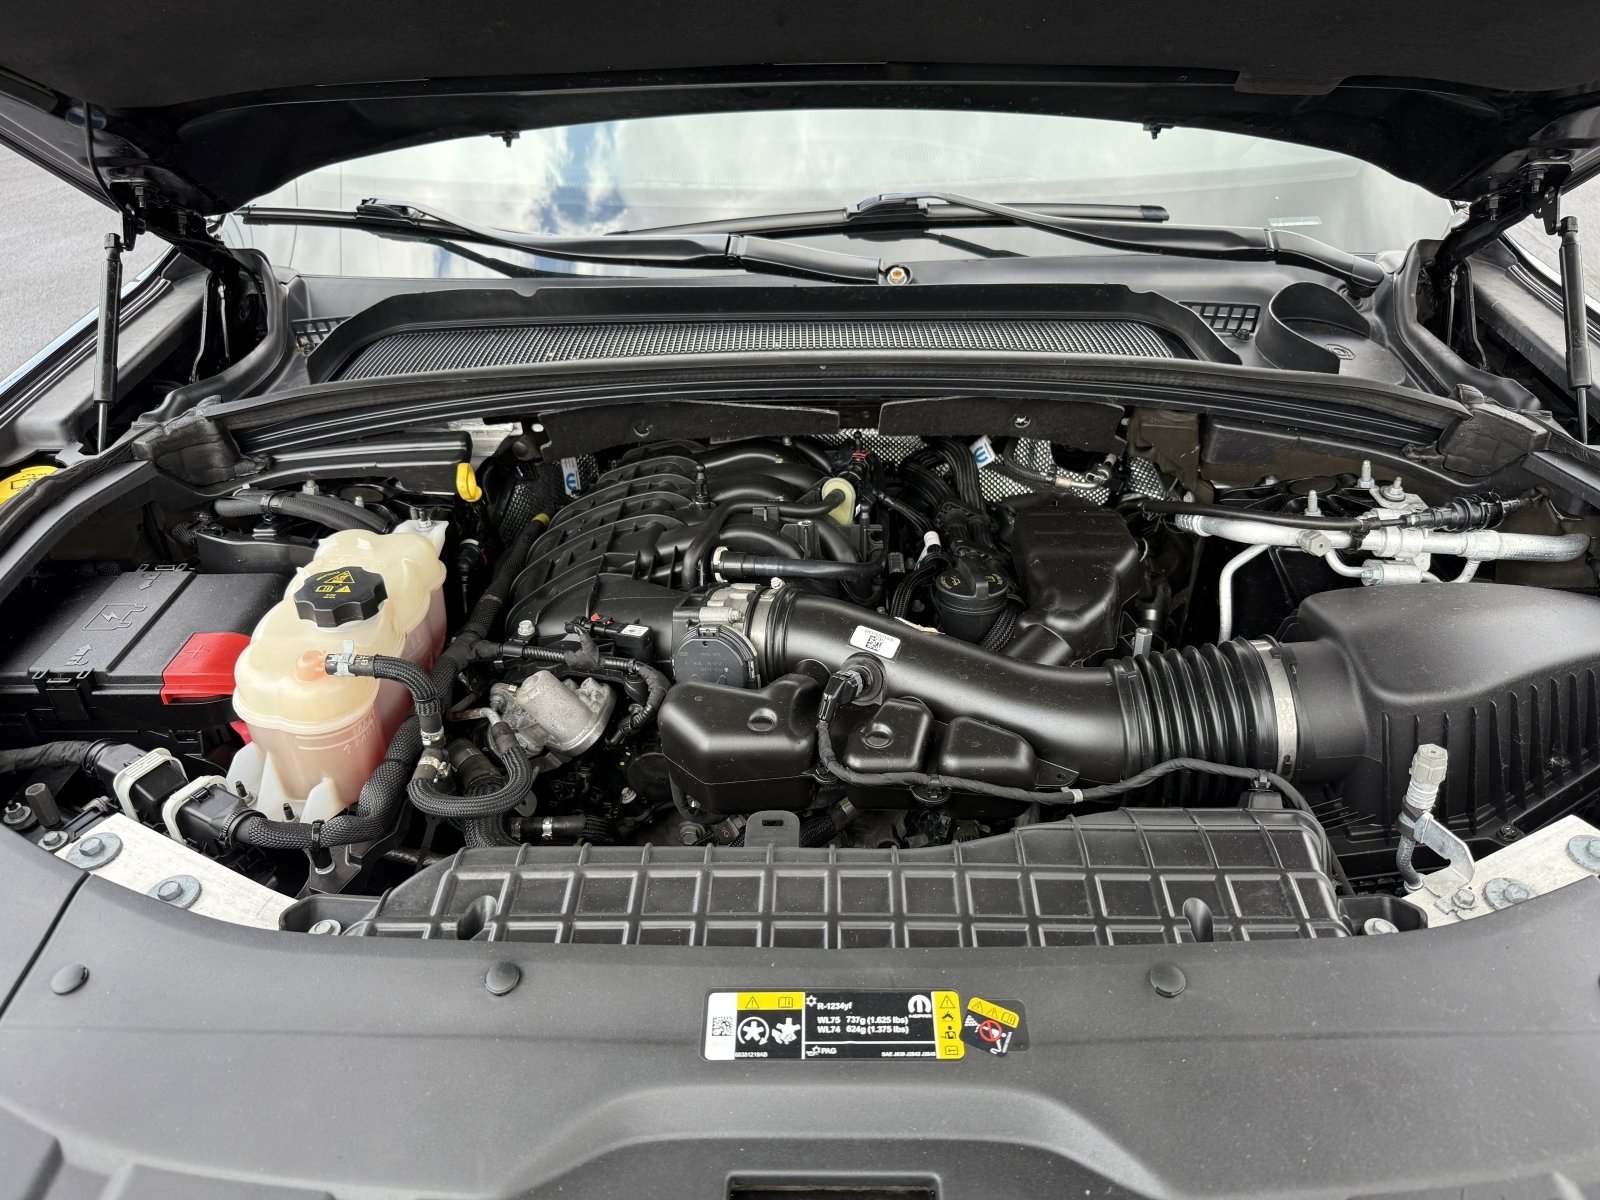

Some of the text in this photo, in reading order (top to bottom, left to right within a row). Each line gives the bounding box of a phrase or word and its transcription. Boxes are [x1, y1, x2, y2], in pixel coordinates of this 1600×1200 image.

[817, 1002, 852, 1011] R-1234yf
[817, 1016, 908, 1025] WL75 737g (1.625 lbs)
[846, 1025, 866, 1034] 624g
[867, 1025, 891, 1034] (1.375
[893, 1025, 909, 1034] lbs)
